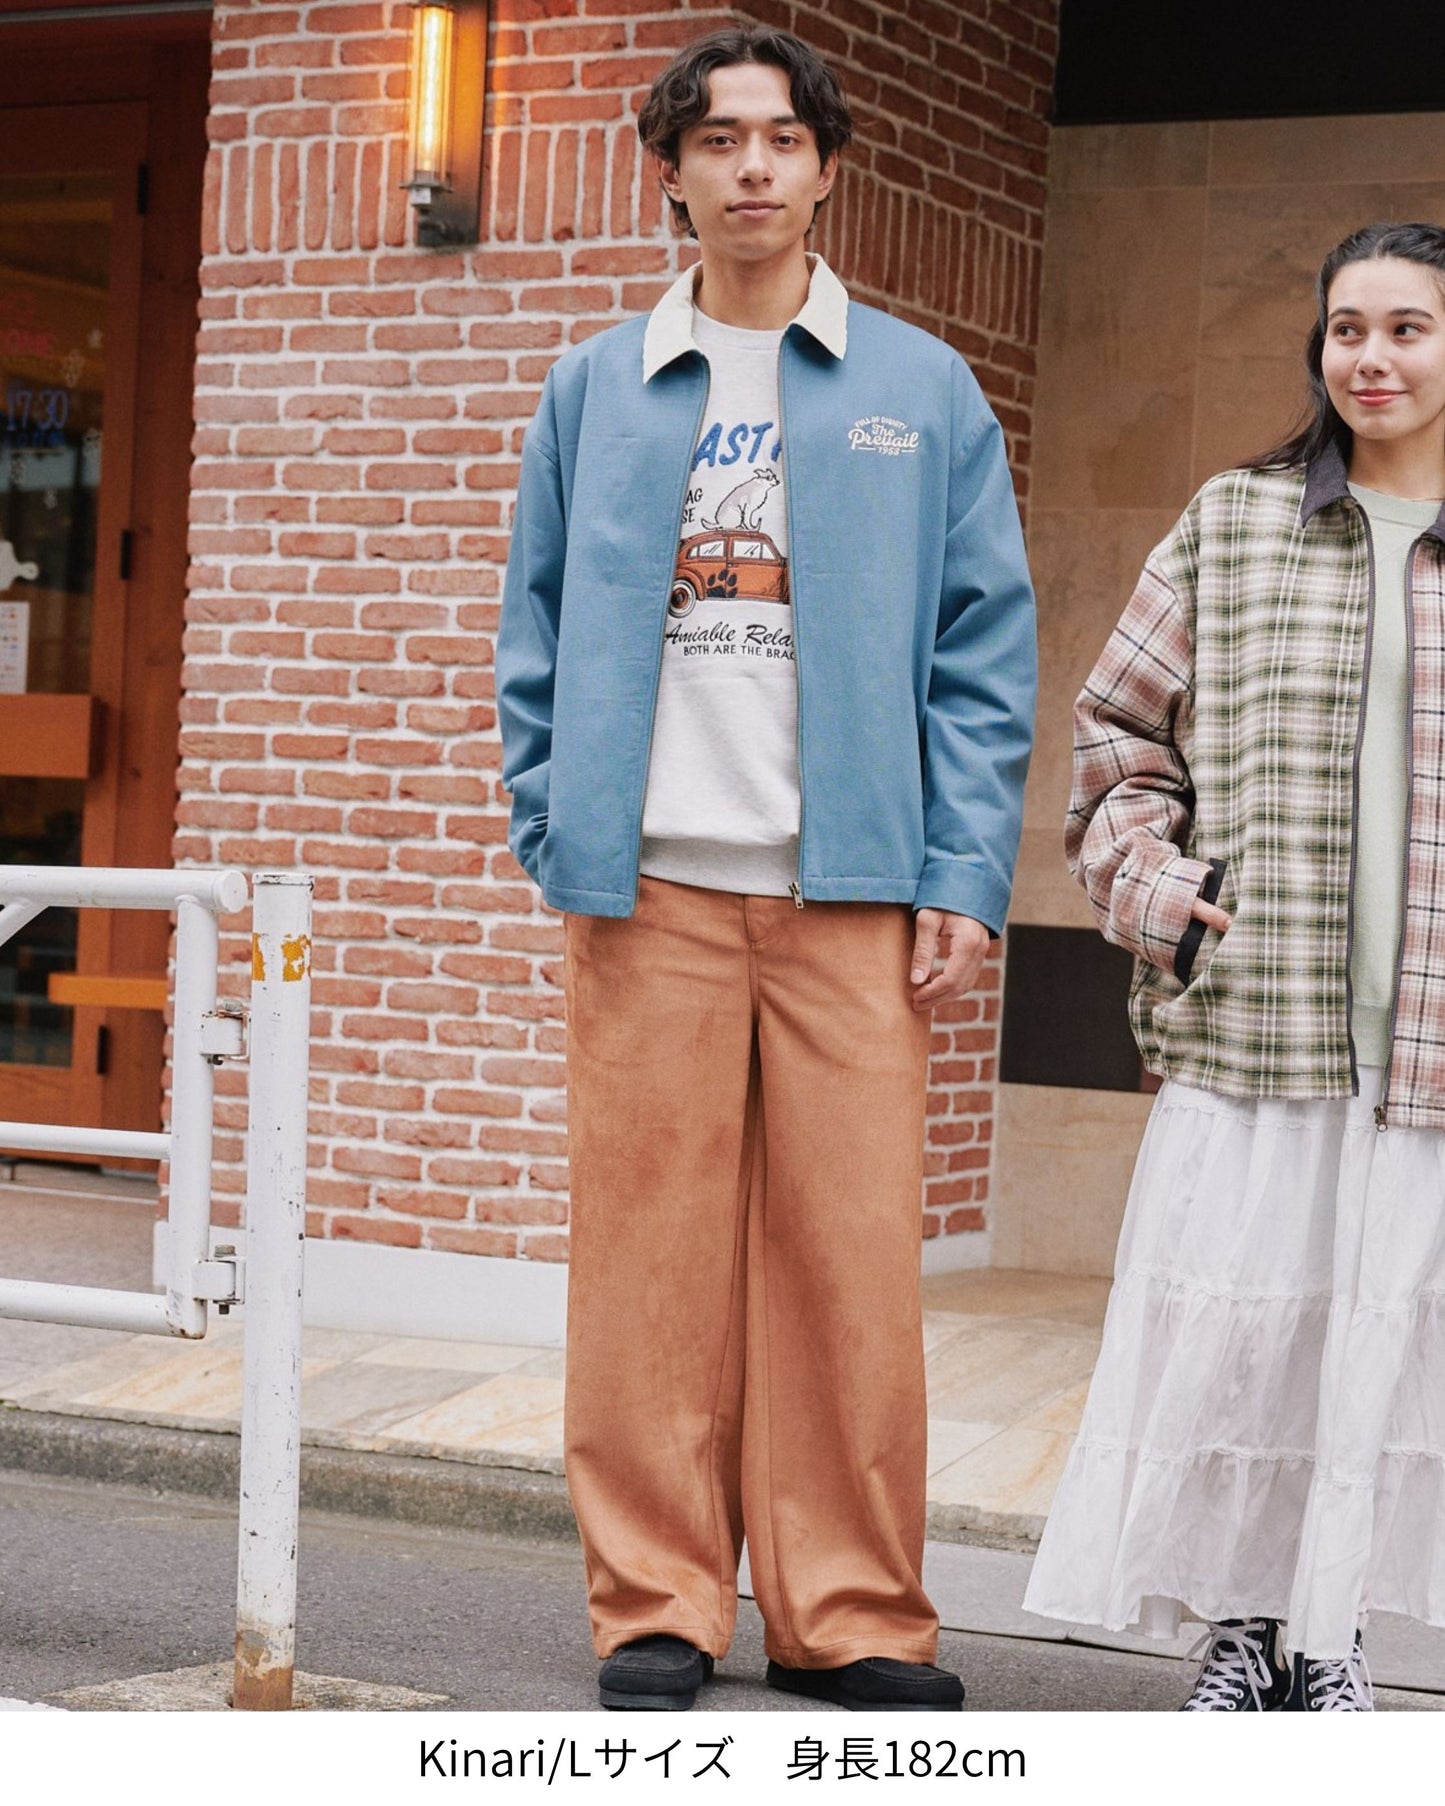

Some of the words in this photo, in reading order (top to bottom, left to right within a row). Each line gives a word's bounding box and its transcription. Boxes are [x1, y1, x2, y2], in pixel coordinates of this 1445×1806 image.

[848, 428, 919, 450] Prevail
[871, 423, 896, 437] The
[664, 621, 736, 645] Amiable
[743, 624, 795, 648] Rela
[683, 645, 710, 657] BOTH
[713, 645, 737, 655] ARE
[741, 645, 762, 656] THE
